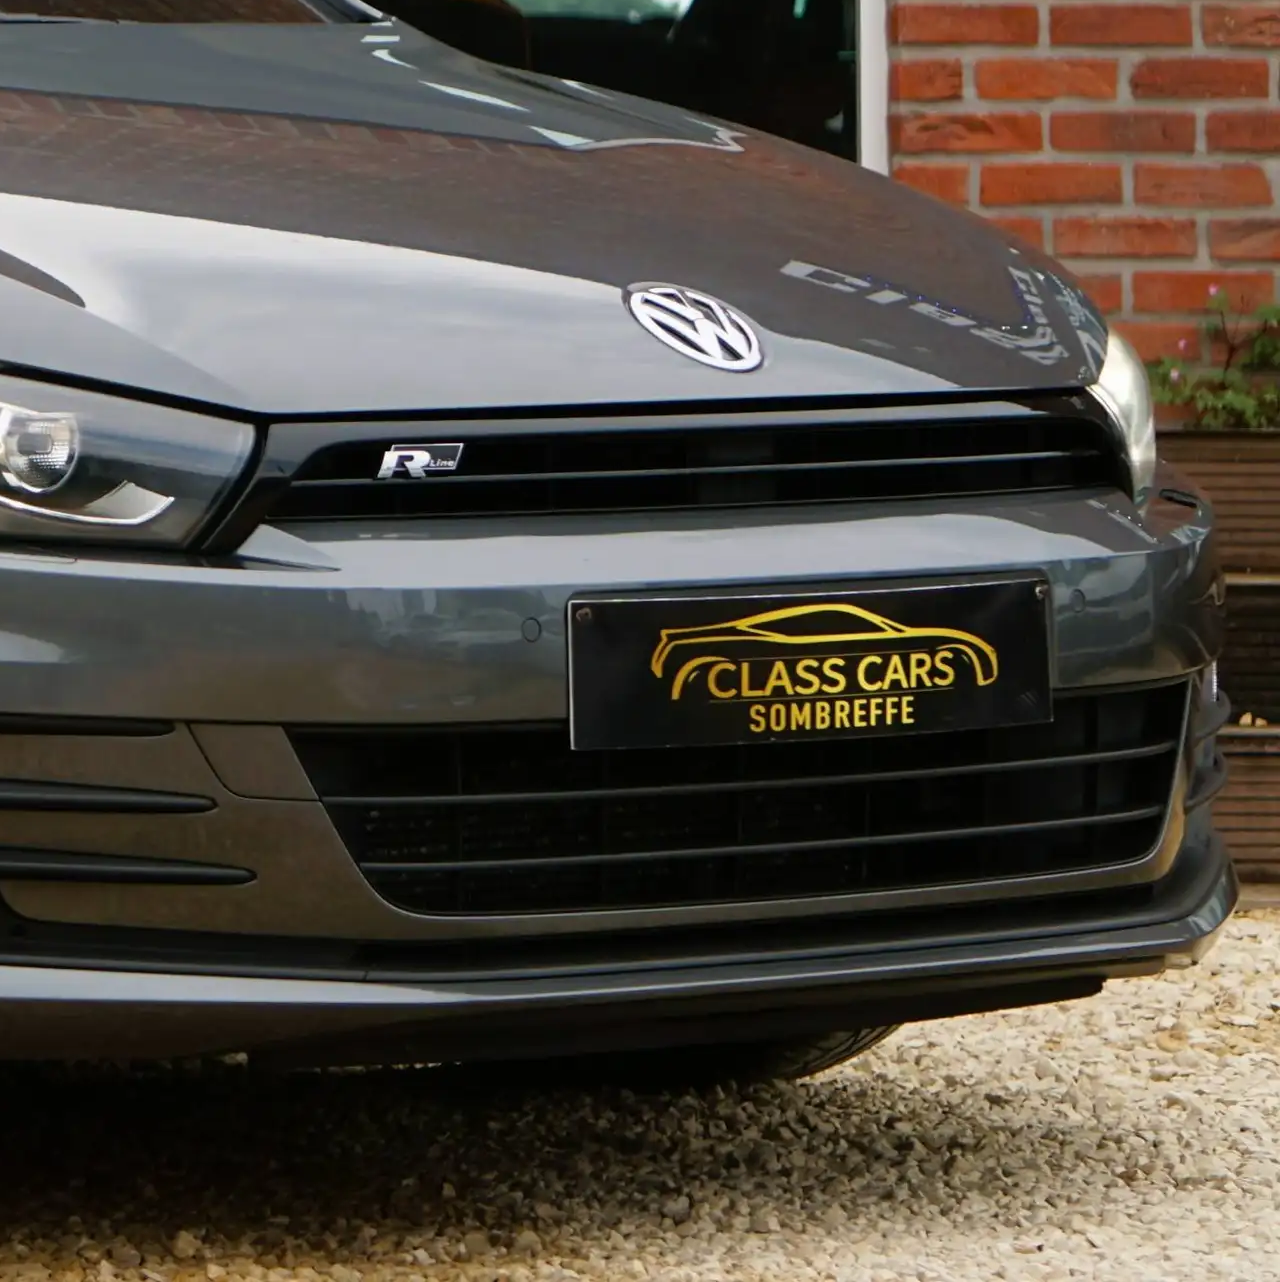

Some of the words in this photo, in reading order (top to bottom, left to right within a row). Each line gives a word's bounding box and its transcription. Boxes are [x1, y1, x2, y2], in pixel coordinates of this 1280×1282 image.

[377, 450, 431, 479] R
[707, 657, 847, 699] CLASS
[857, 650, 955, 692] CARS
[749, 696, 915, 733] SOMBREFFE
